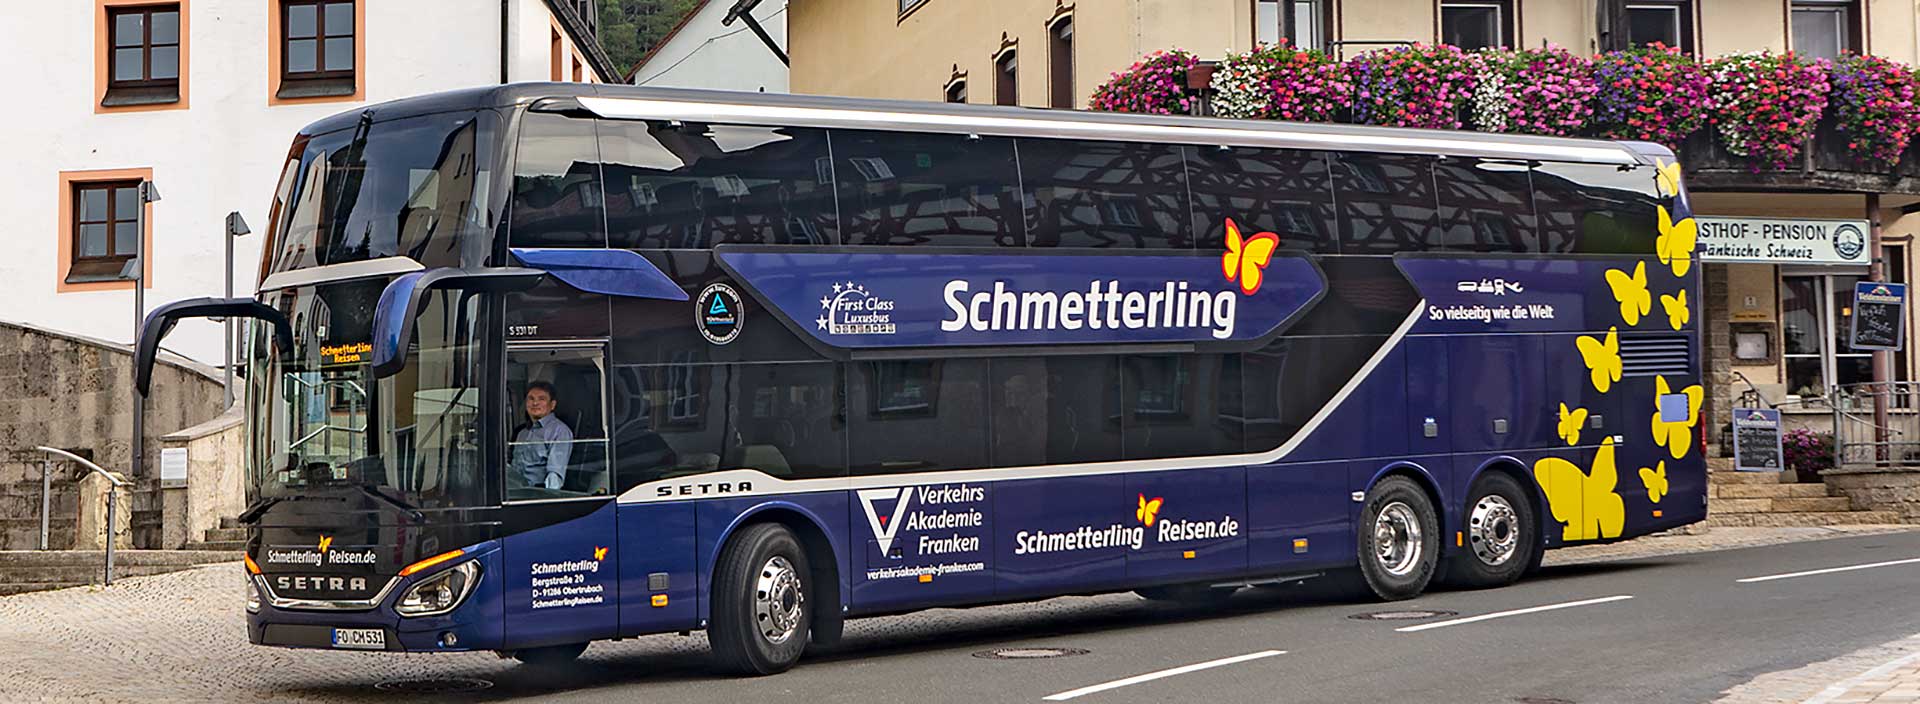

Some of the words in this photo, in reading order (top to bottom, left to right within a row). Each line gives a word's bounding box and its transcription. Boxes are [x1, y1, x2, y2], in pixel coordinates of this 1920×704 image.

[1763, 223, 1827, 240] PENSION
[1703, 242, 1760, 257] änkische
[1767, 243, 1813, 259] Schweiz
[837, 297, 864, 311] First
[865, 297, 894, 311] Class
[940, 279, 1237, 339] Schmetterling
[844, 311, 890, 323] Luxusbus
[1429, 305, 1444, 320] So
[1444, 305, 1491, 323] vielseitig
[1491, 305, 1511, 319] wie
[1512, 304, 1528, 319] die
[1528, 304, 1554, 319] Welt
[509, 326, 515, 335] S
[334, 353, 361, 363] Reisen
[657, 482, 752, 496] SETRA
[917, 484, 984, 505] Verkehrs
[905, 508, 983, 531] Akademie
[1015, 525, 1143, 554] Schmetterling
[1158, 516, 1239, 542] Reisen.de
[918, 533, 979, 555] Franken
[267, 550, 322, 566] Schmetterling
[328, 550, 376, 563] Reisen.de
[531, 560, 599, 575] Schmetterling
[867, 562, 984, 579] verkehrsakademie-franken.com
[277, 576, 366, 590] SETRA
[532, 575, 573, 587] Bergstraße
[574, 574, 584, 583] 20
[562, 584, 603, 595] Obertrubach
[337, 630, 348, 643] FO
